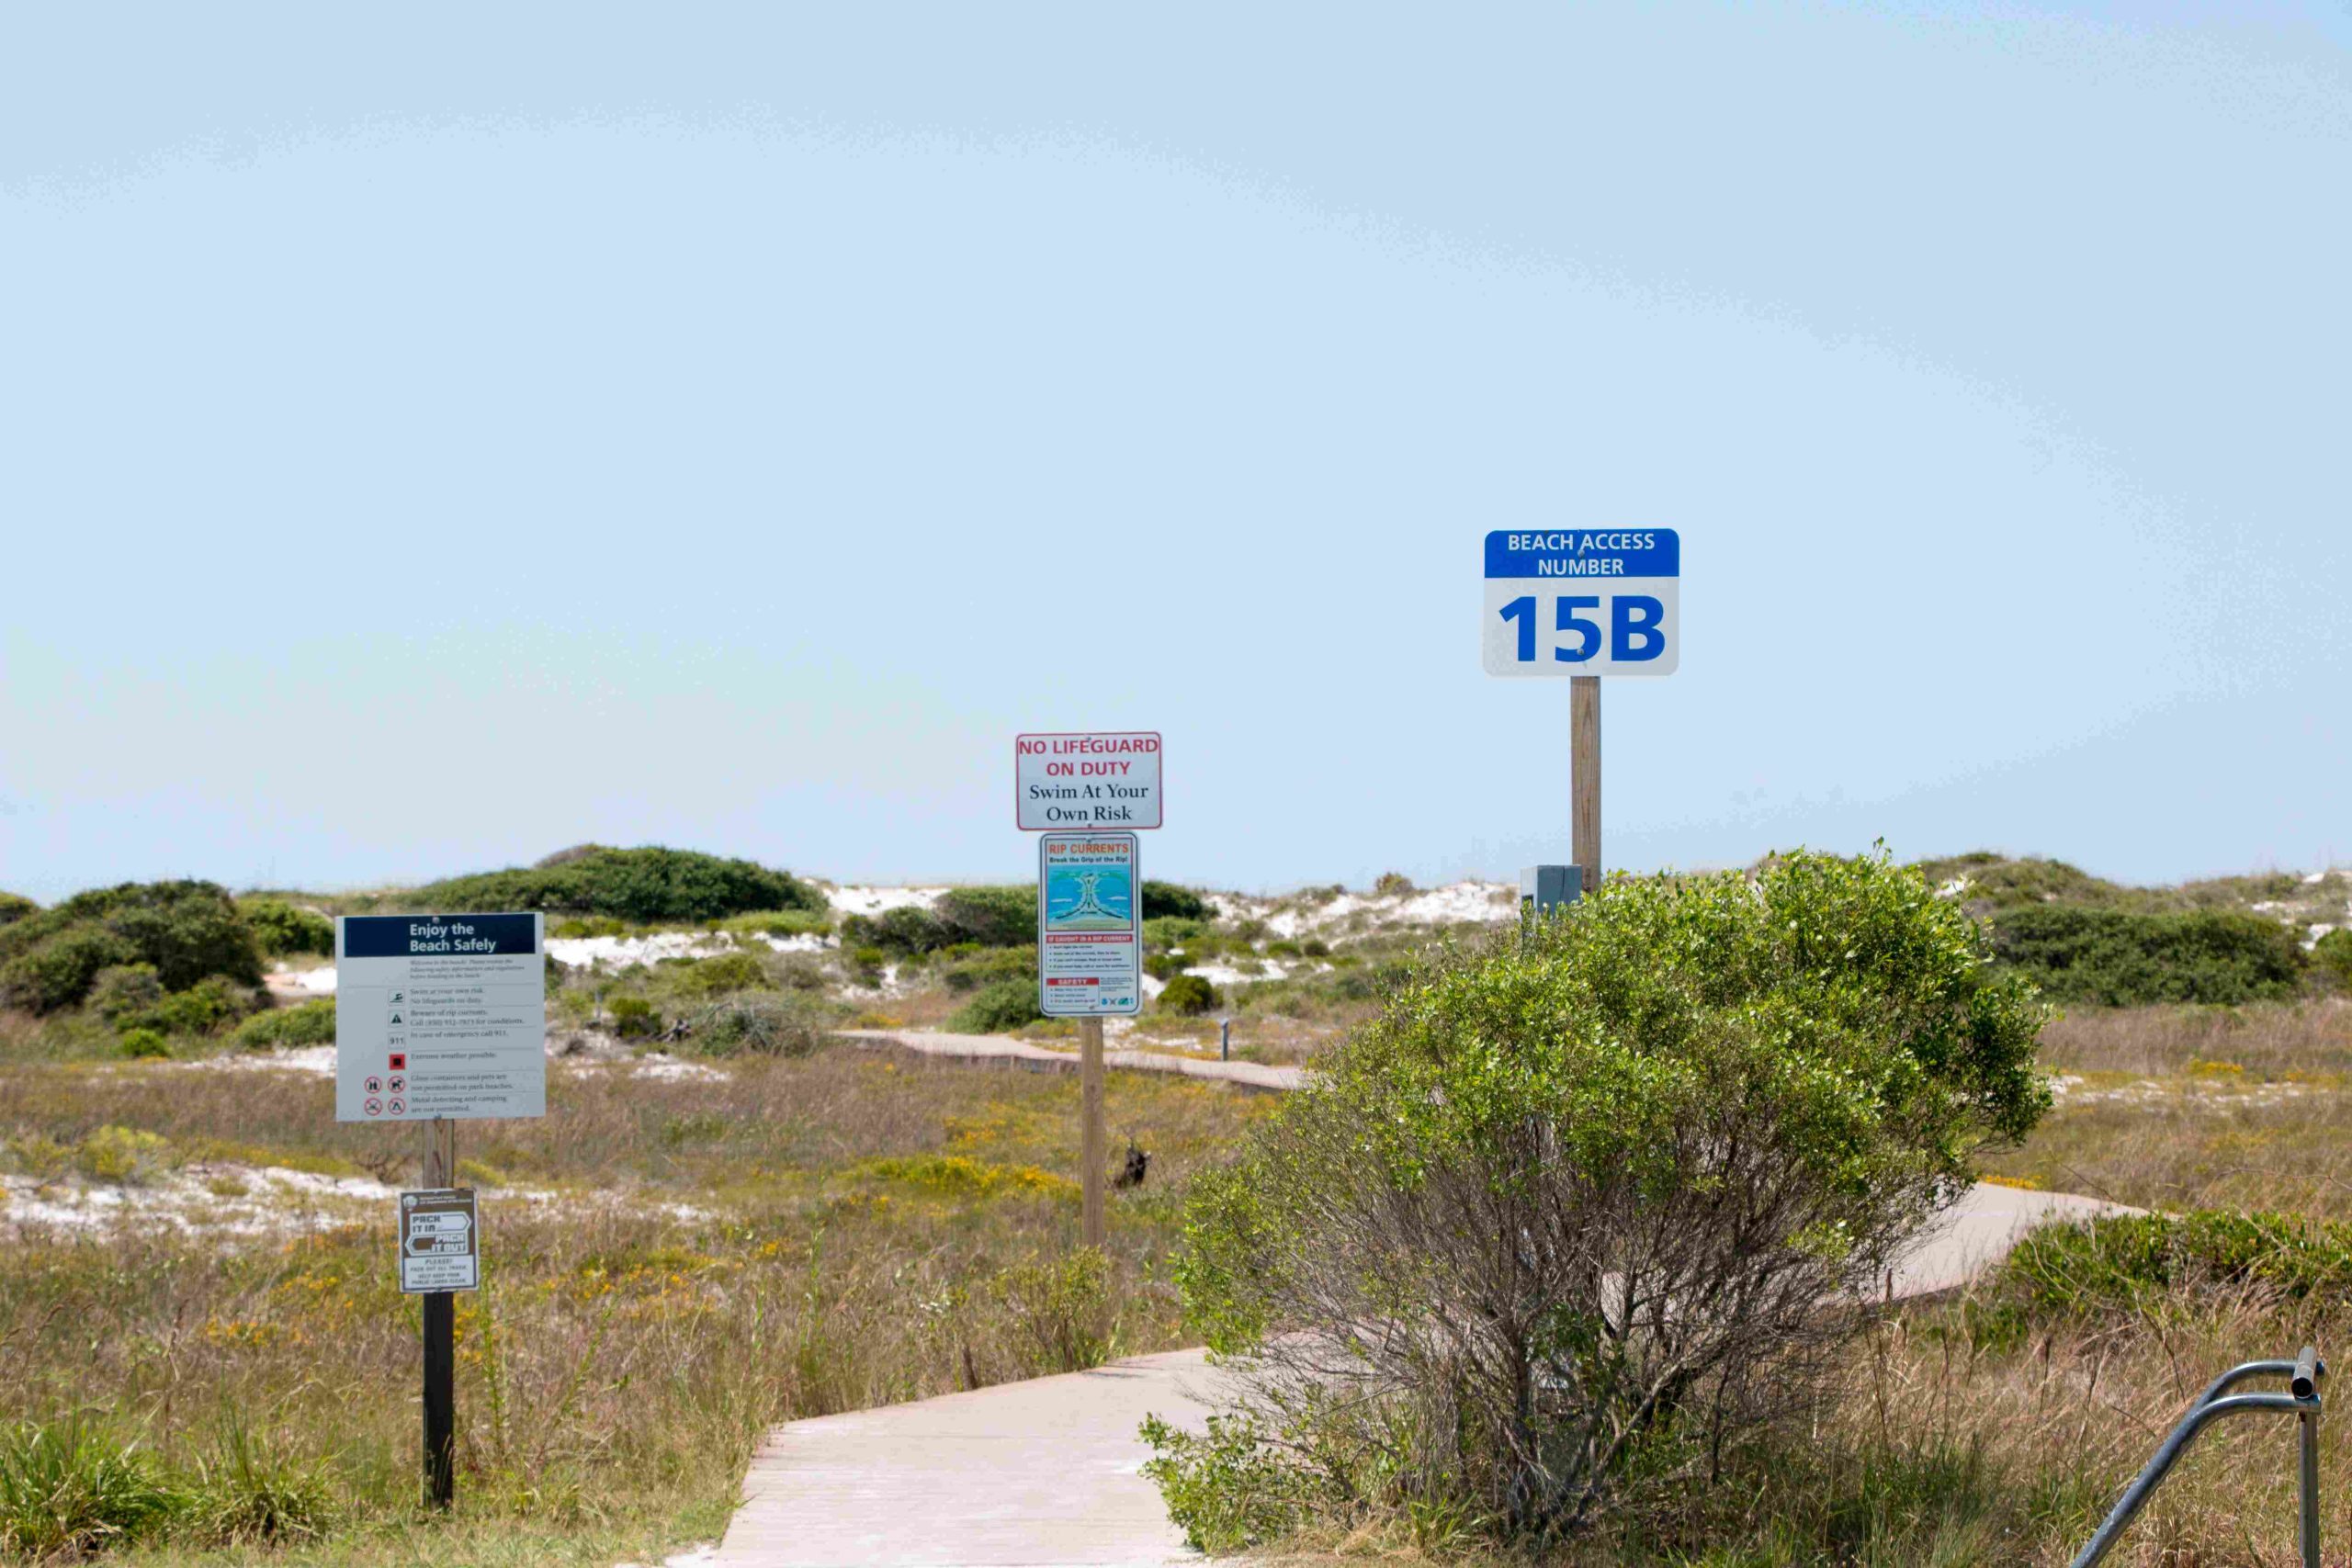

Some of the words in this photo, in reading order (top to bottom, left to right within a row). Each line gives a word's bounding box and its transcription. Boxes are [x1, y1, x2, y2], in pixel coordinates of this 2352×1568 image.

[1508, 534, 1573, 551] BEACH
[1579, 533, 1655, 550] ACCESS
[1538, 558, 1624, 575] NUMBER
[1498, 595, 1666, 662] 15B
[1019, 740, 1046, 754] NO
[1053, 739, 1159, 754] LIFEGUARD
[1046, 761, 1074, 776] ON
[1081, 761, 1131, 775] DUTY
[1029, 784, 1078, 799] Swim
[1082, 784, 1102, 798] At
[1106, 784, 1149, 798] Your
[1046, 807, 1089, 821] Own
[1094, 806, 1133, 820] Risk
[1049, 843, 1067, 854] RIP
[1070, 843, 1129, 853] CURRENTS
[410, 923, 447, 938] Enjoy
[451, 922, 474, 935] the
[410, 939, 449, 952] Beach
[454, 938, 497, 953] Safely
[413, 1215, 441, 1224] PACK
[413, 1224, 423, 1233] IT
[435, 1234, 465, 1244] PACK
[431, 1243, 442, 1253] IT
[443, 1242, 466, 1253] OUT
